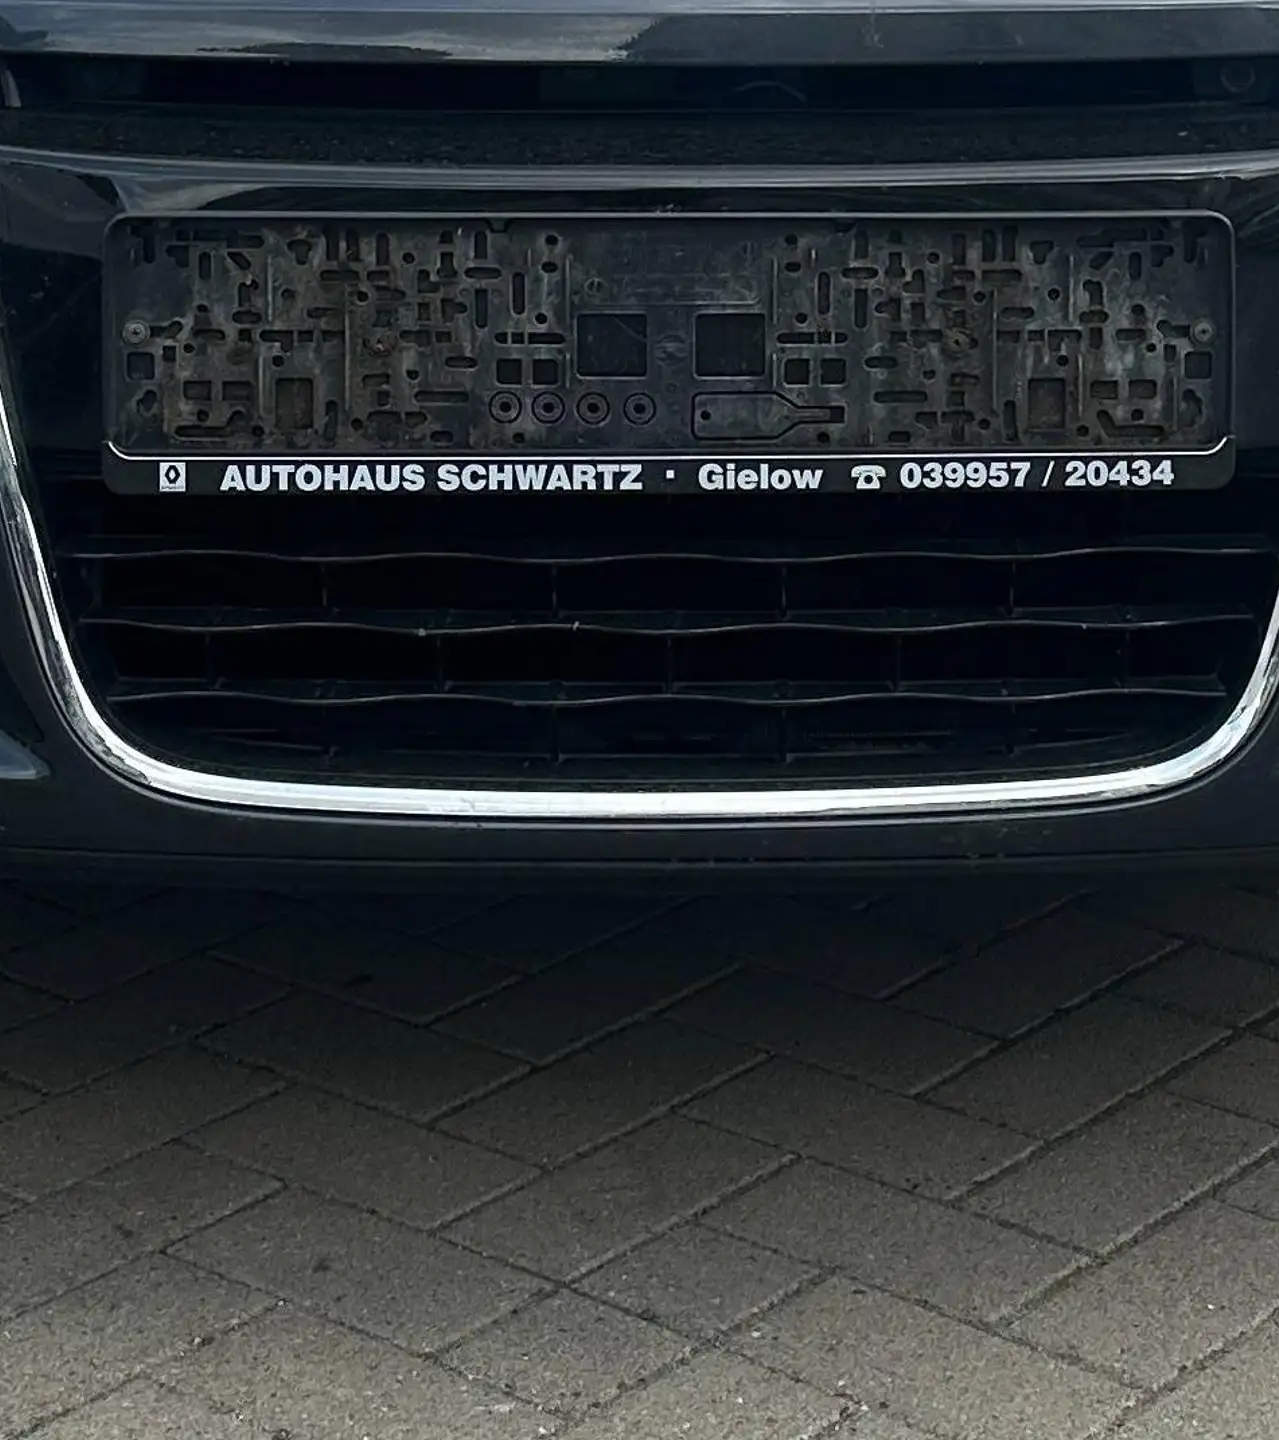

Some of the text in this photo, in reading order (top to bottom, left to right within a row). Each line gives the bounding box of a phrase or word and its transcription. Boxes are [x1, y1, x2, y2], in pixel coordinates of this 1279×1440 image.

[219, 463, 426, 492] AUTOHAUS
[437, 463, 643, 491] SCHWARTZ
[697, 462, 824, 491] Gielow
[899, 461, 1032, 489] 039957
[1064, 460, 1175, 487] 20434
